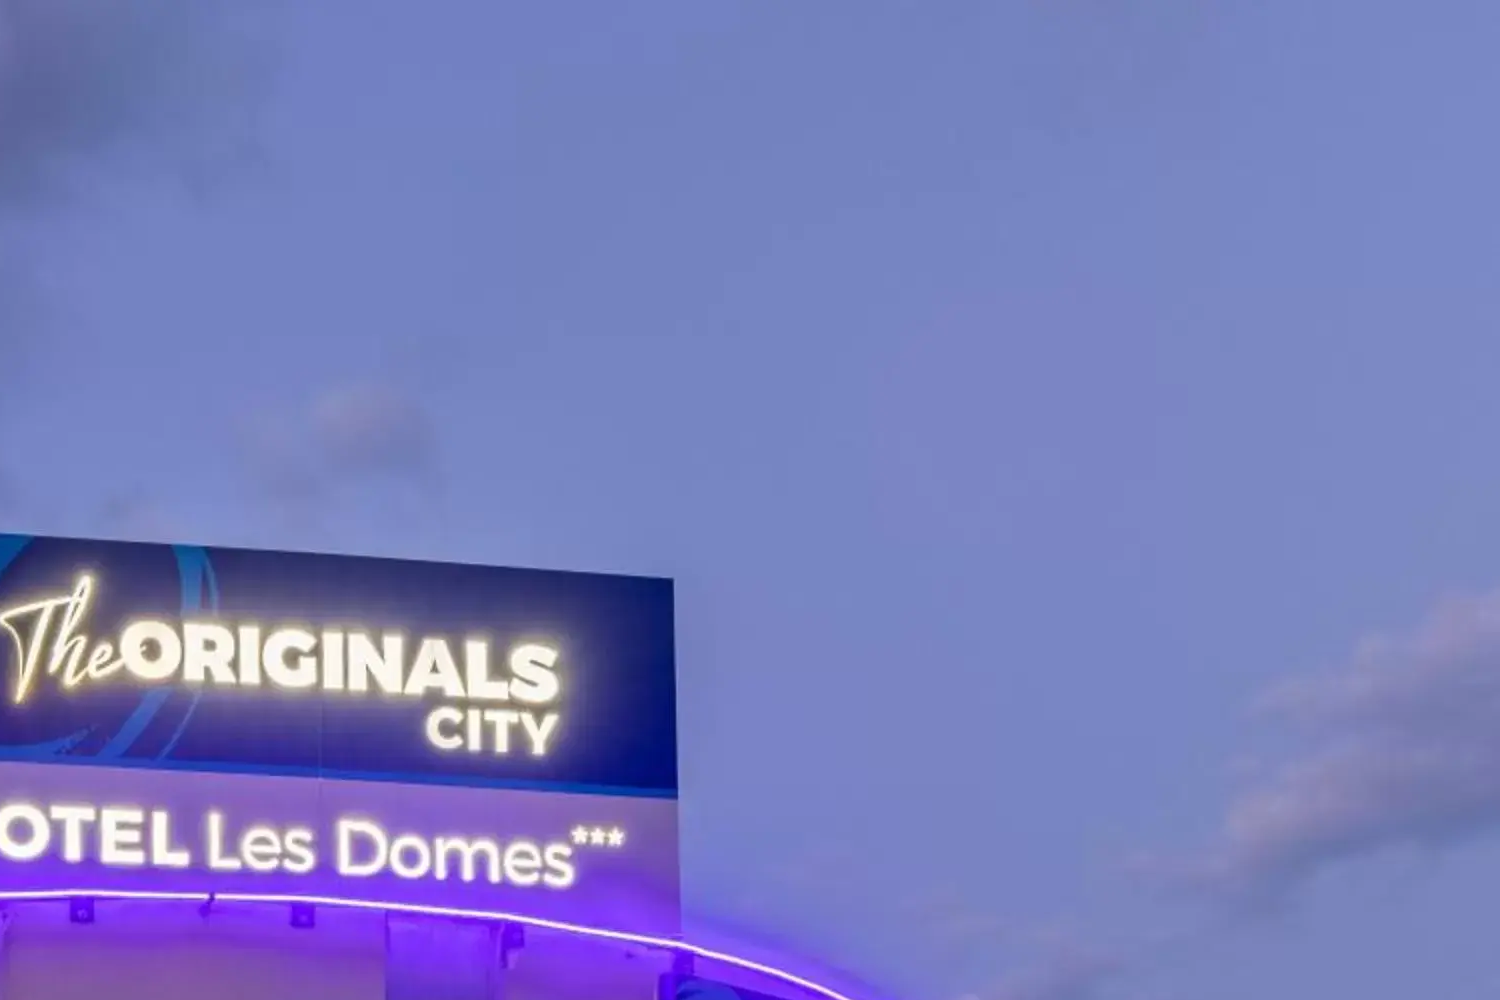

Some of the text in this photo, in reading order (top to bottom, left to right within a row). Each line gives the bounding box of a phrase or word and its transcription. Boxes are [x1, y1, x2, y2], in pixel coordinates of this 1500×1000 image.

[120, 620, 560, 703] ORIGINALS
[426, 706, 557, 756] CITY
[209, 812, 316, 873] Les
